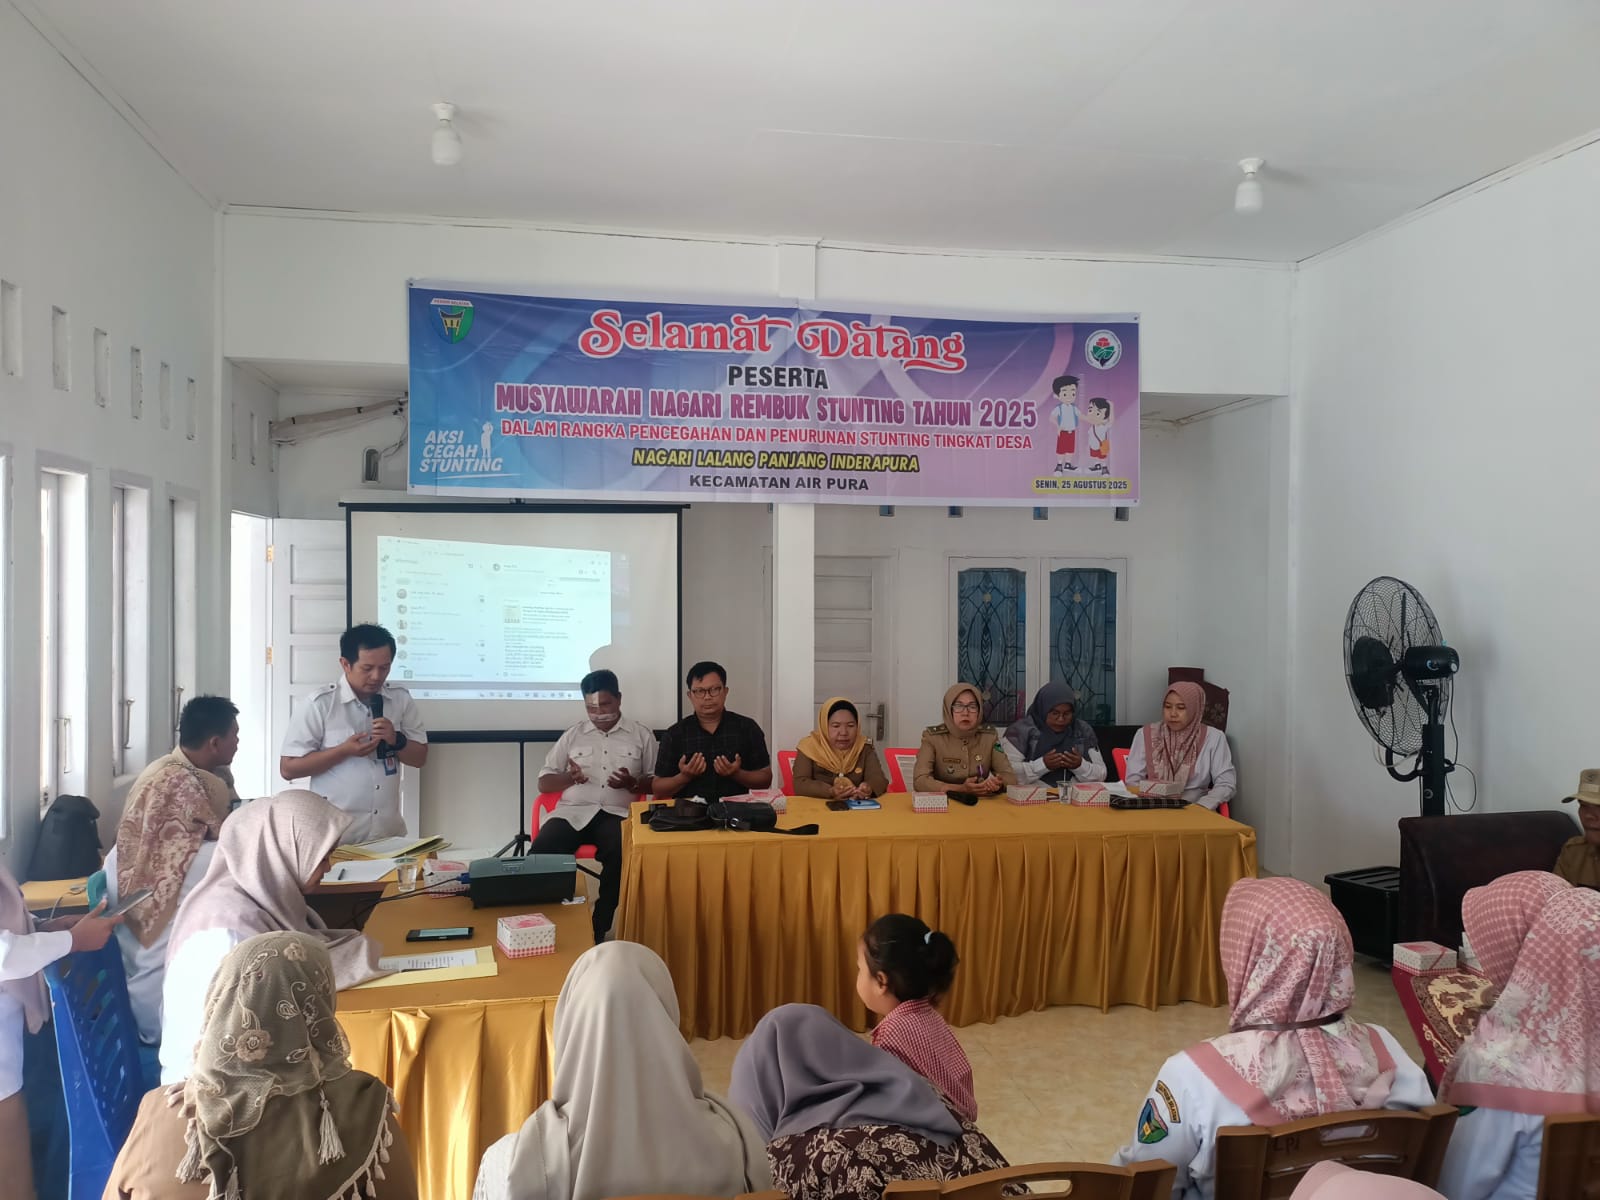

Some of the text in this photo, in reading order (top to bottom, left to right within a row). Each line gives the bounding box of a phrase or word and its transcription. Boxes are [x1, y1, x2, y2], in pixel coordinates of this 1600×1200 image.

[580, 309, 967, 373] Selamat Datang
[728, 365, 829, 389] PESERTA
[496, 383, 1037, 428] MUSYAWARAH NAGARI REMBUK STUNTING TAHUN 2025
[425, 430, 464, 444] AKSI
[501, 420, 1033, 449] DALAM RANGKA PENCEGAHAN DAN PENURUNAN STUNTING TINGKAT DESA
[422, 444, 478, 458] CEGAH
[632, 448, 920, 473] NAGARI LALANG PANJANG INDERAPURA
[419, 457, 503, 473] STUNTING
[689, 474, 869, 490] KECAMATAN AIR PURA
[1035, 479, 1128, 490] SENIN, 25 AGUSTUS 2025
